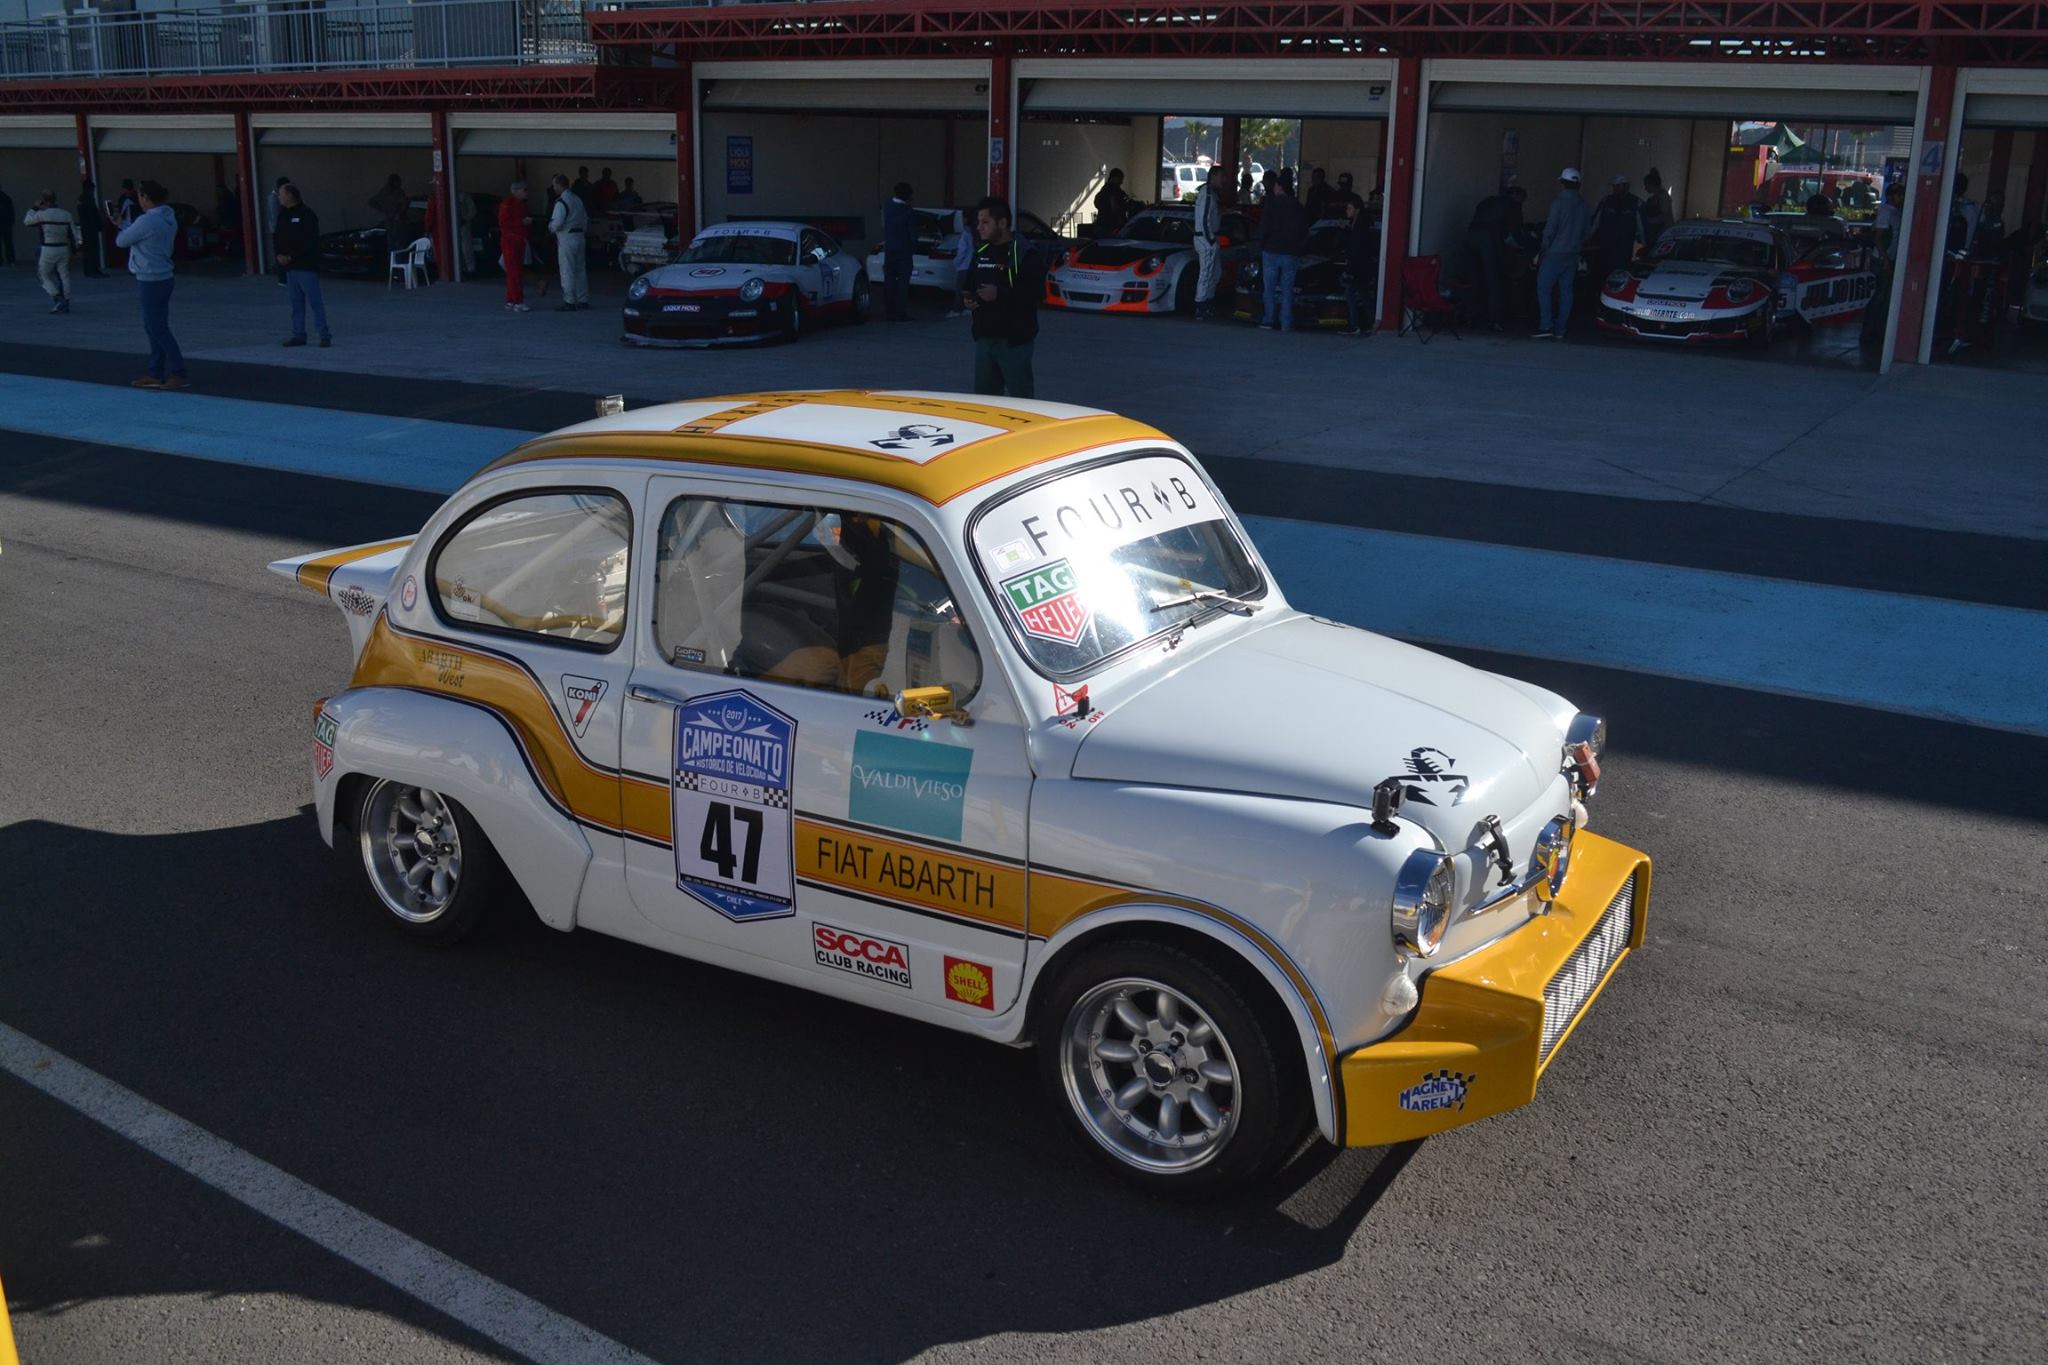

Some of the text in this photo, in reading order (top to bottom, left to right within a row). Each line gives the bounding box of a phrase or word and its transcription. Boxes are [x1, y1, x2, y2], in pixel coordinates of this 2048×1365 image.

[991, 140, 1002, 162] 5
[1922, 143, 1941, 173] 4
[662, 304, 701, 312] LIQUI MOLY
[1021, 486, 1153, 557] FOUR
[1168, 476, 1197, 510] B
[1010, 567, 1074, 604] TAG
[568, 687, 597, 701] KONI
[726, 710, 743, 720] 2017
[1059, 711, 1105, 729] ON OFF
[316, 717, 335, 746] TAG
[682, 727, 783, 778] CAMPEONATO
[726, 759, 735, 774] DE
[700, 778, 761, 800] FOUR B
[700, 801, 763, 885] 47
[817, 837, 995, 909] FIAT ABARTH
[815, 927, 907, 970] SCCA
[817, 950, 909, 985] CLUB RACING
[953, 974, 984, 991] SHELL
